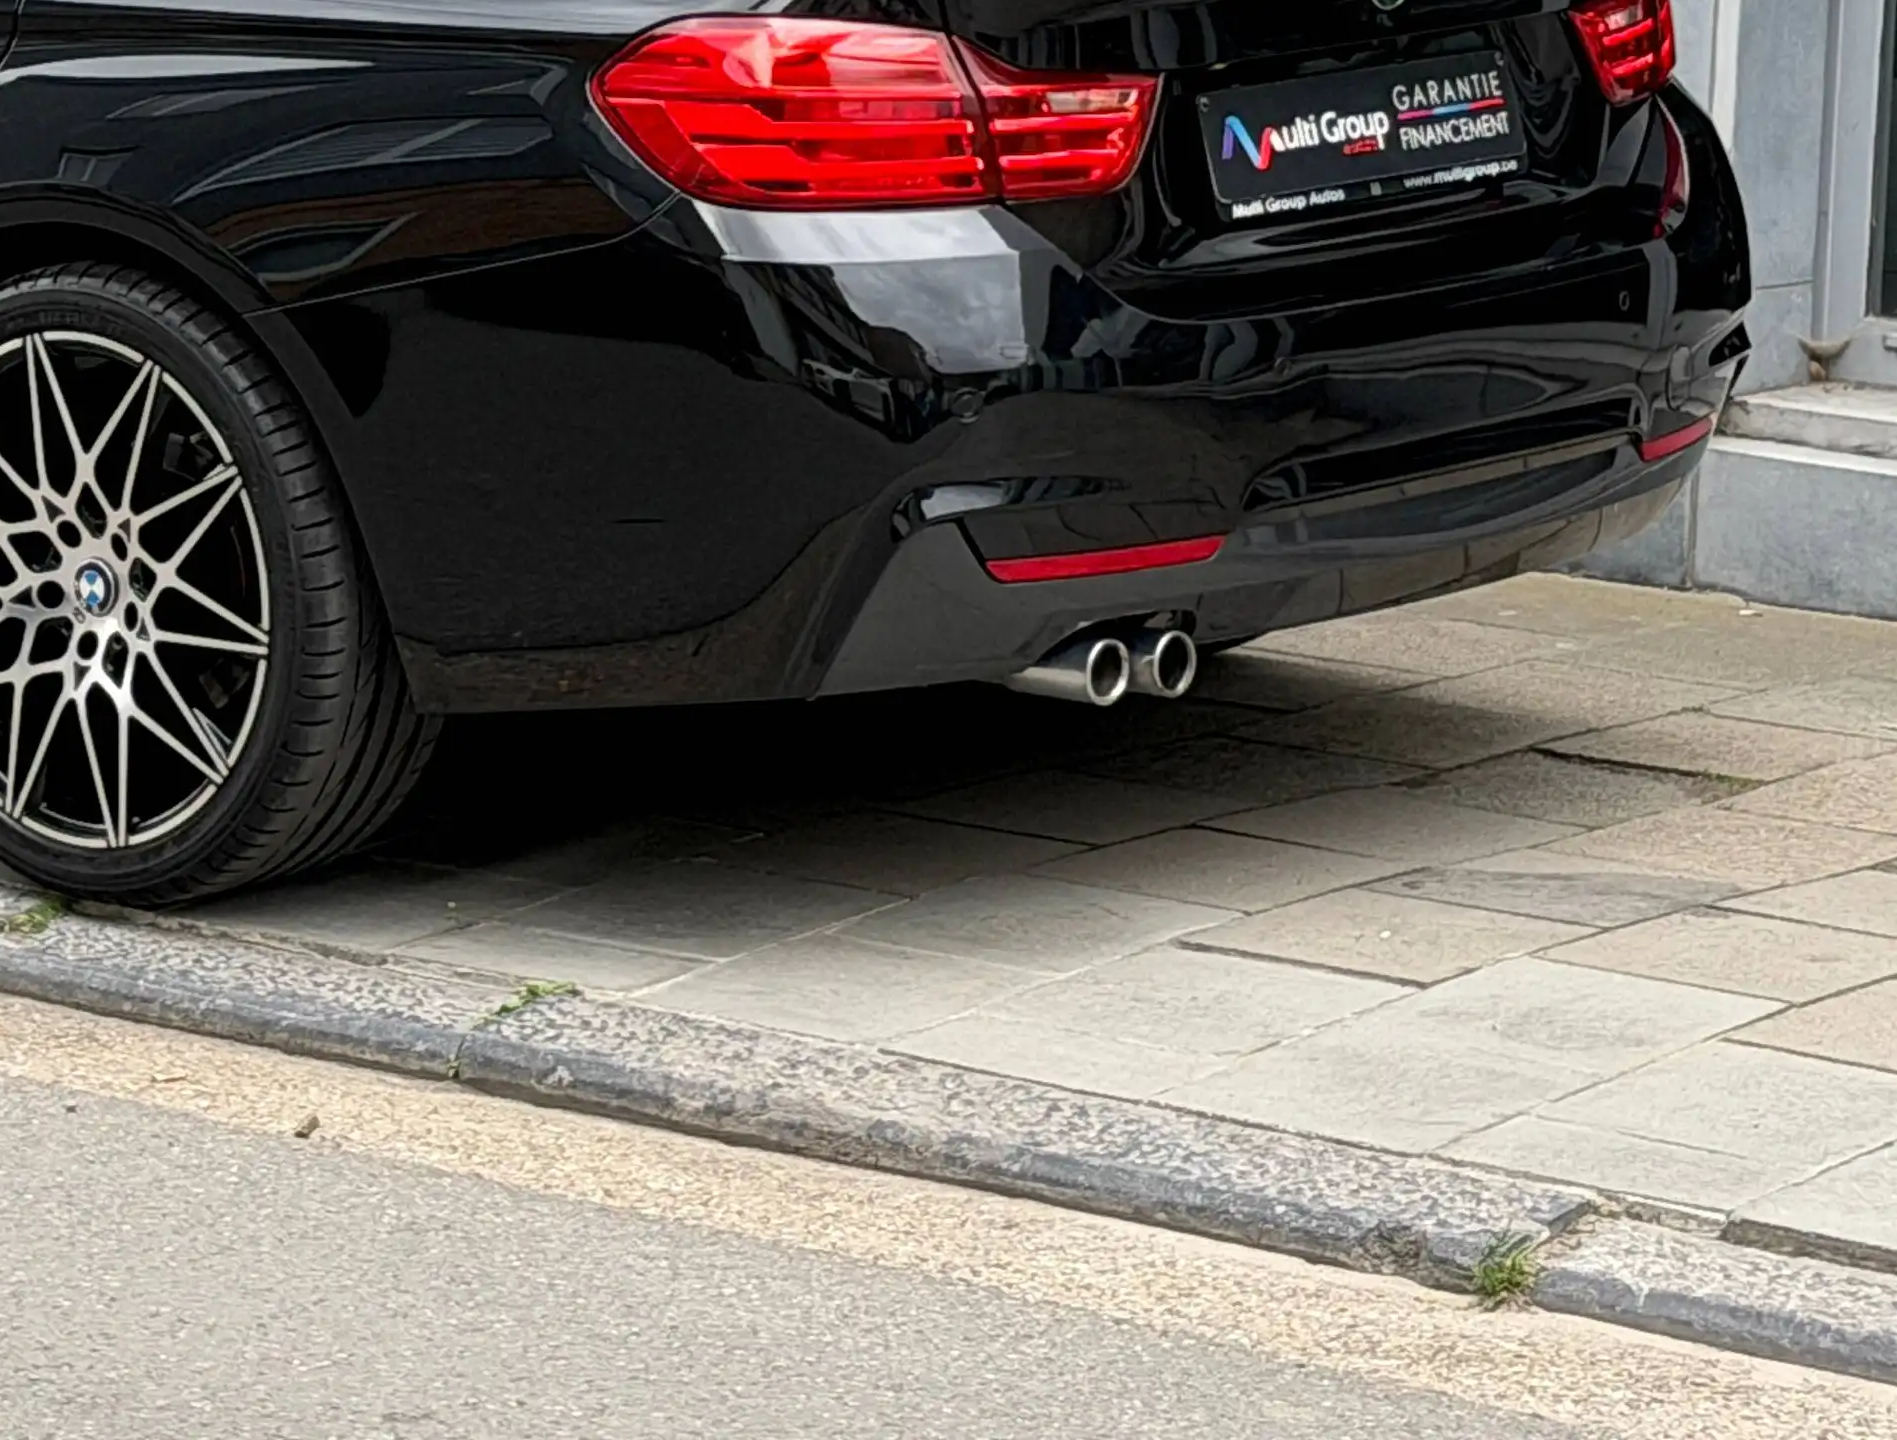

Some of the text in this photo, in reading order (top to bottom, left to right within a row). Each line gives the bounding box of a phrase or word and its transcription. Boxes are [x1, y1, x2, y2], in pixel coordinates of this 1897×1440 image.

[1392, 70, 1503, 111] GARANTIE
[1221, 110, 1390, 171] Multi Group
[1399, 111, 1510, 151] FINANCEMENT
[1403, 159, 1519, 189] www.multigroup.be
[1232, 187, 1346, 220] Multi Group Autos
